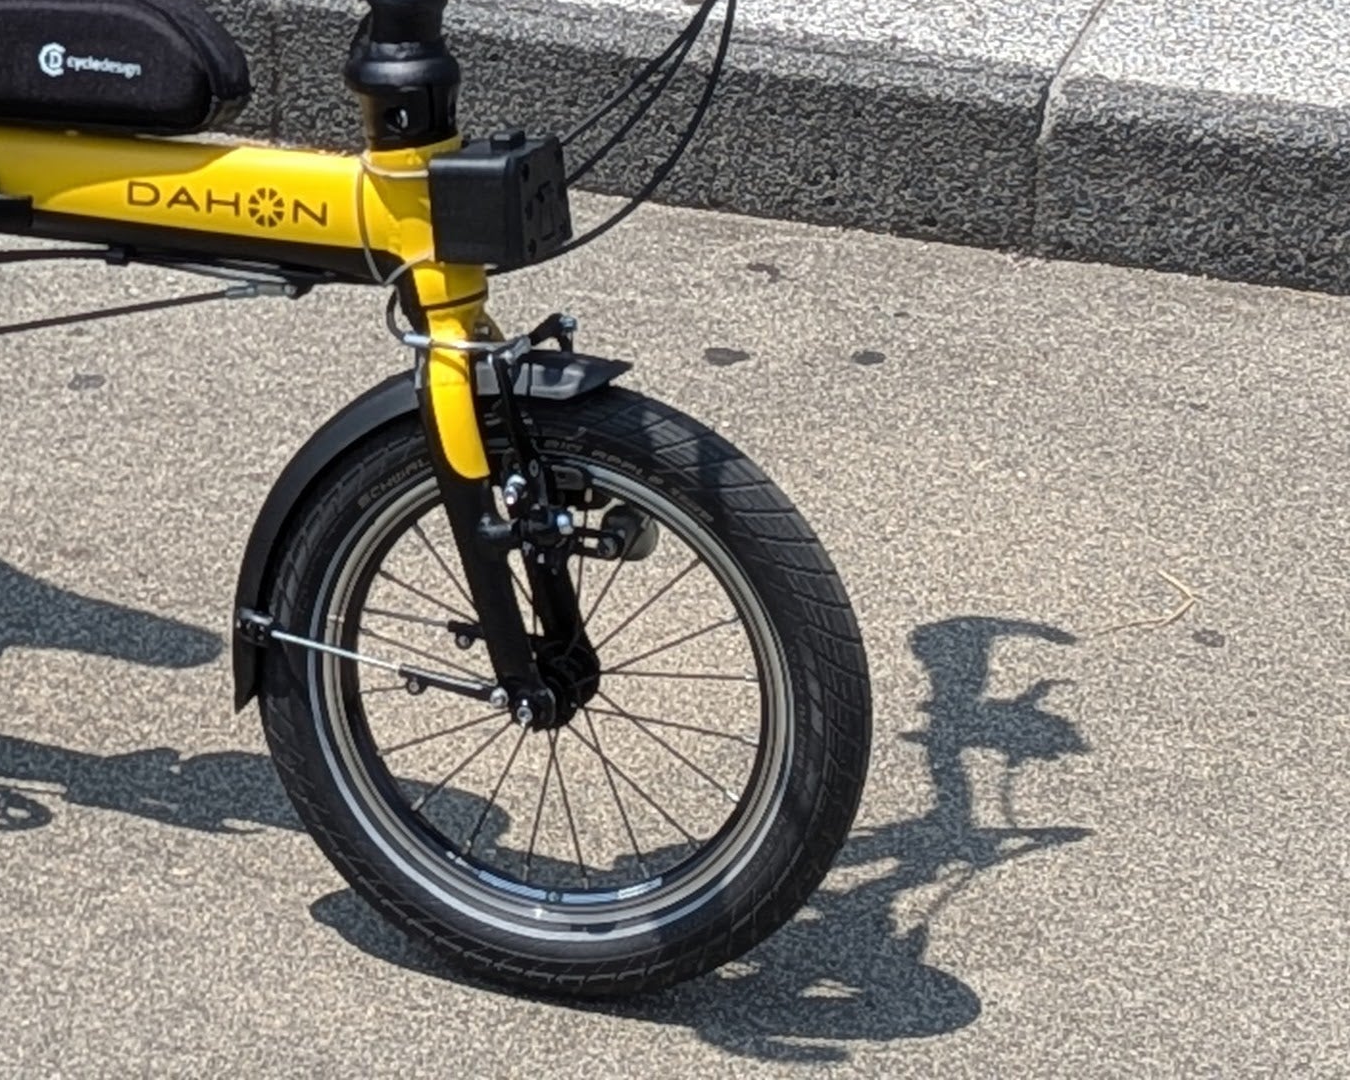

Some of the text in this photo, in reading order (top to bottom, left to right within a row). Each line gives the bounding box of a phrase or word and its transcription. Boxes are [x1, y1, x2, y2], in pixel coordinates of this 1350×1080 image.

[66, 55, 142, 79] cycledesign
[126, 180, 328, 228] DAHON
[357, 458, 432, 510] SCHWAL
